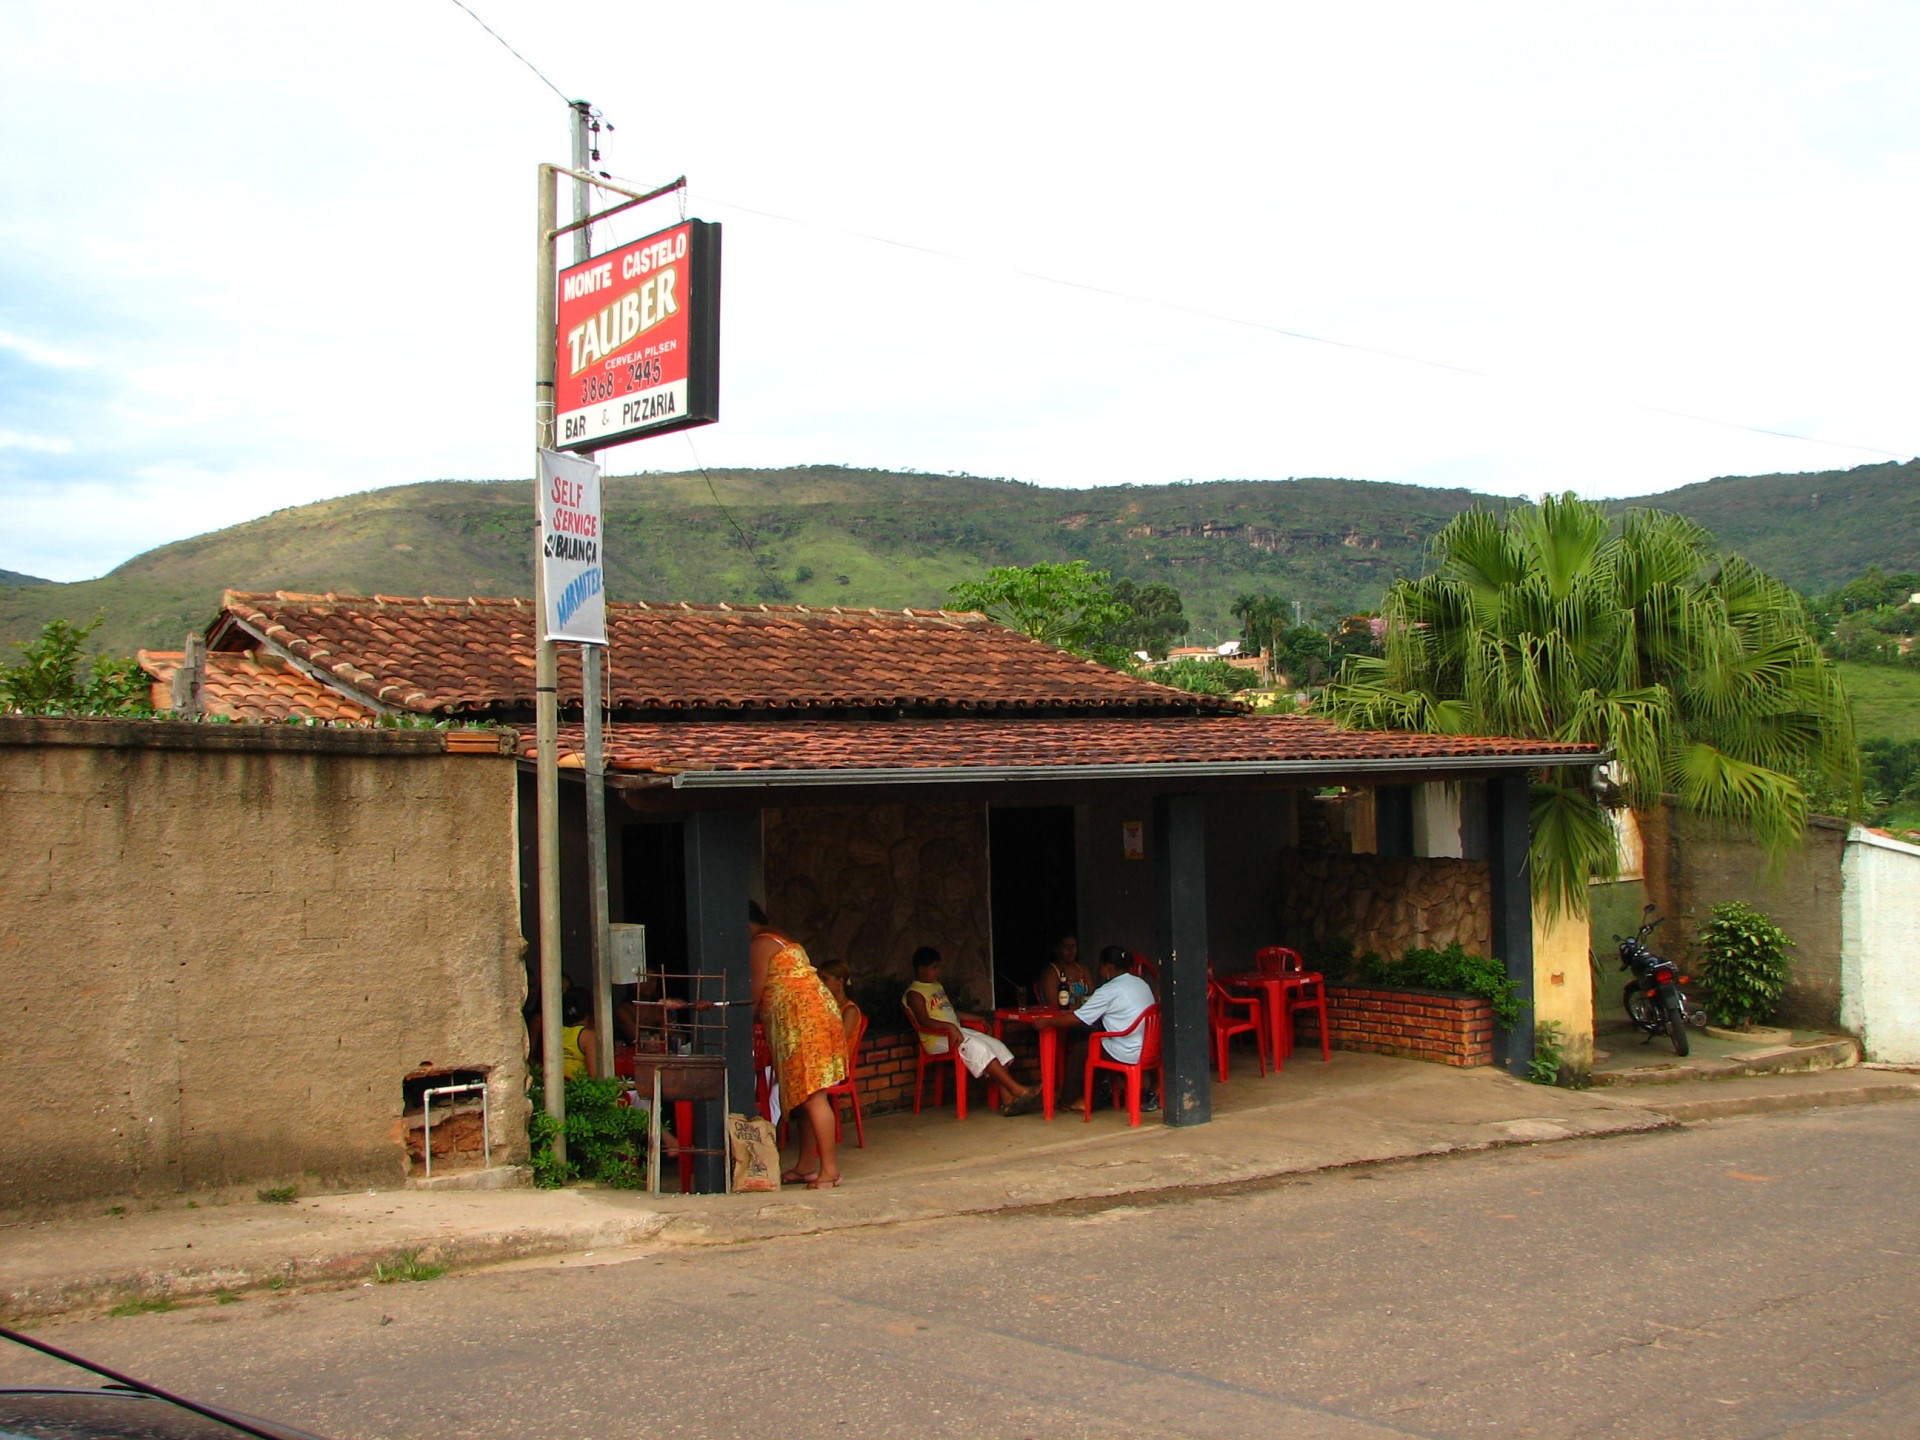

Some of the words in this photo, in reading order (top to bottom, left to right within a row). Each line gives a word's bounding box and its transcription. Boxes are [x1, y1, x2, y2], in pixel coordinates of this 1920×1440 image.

[564, 262, 613, 302] MONTE
[622, 232, 687, 280] CASTELO
[567, 267, 679, 376] TAUBER
[605, 351, 642, 371] CERVEJA
[644, 339, 677, 358] PILSEN
[581, 372, 615, 404] 3868
[626, 358, 661, 393] 2445
[565, 415, 586, 440] BAR
[602, 409, 610, 426] &
[623, 391, 675, 425] PIZZARIA
[551, 476, 583, 508] SELF
[553, 508, 597, 537] SERVICE
[557, 567, 601, 631] MARMITEX
